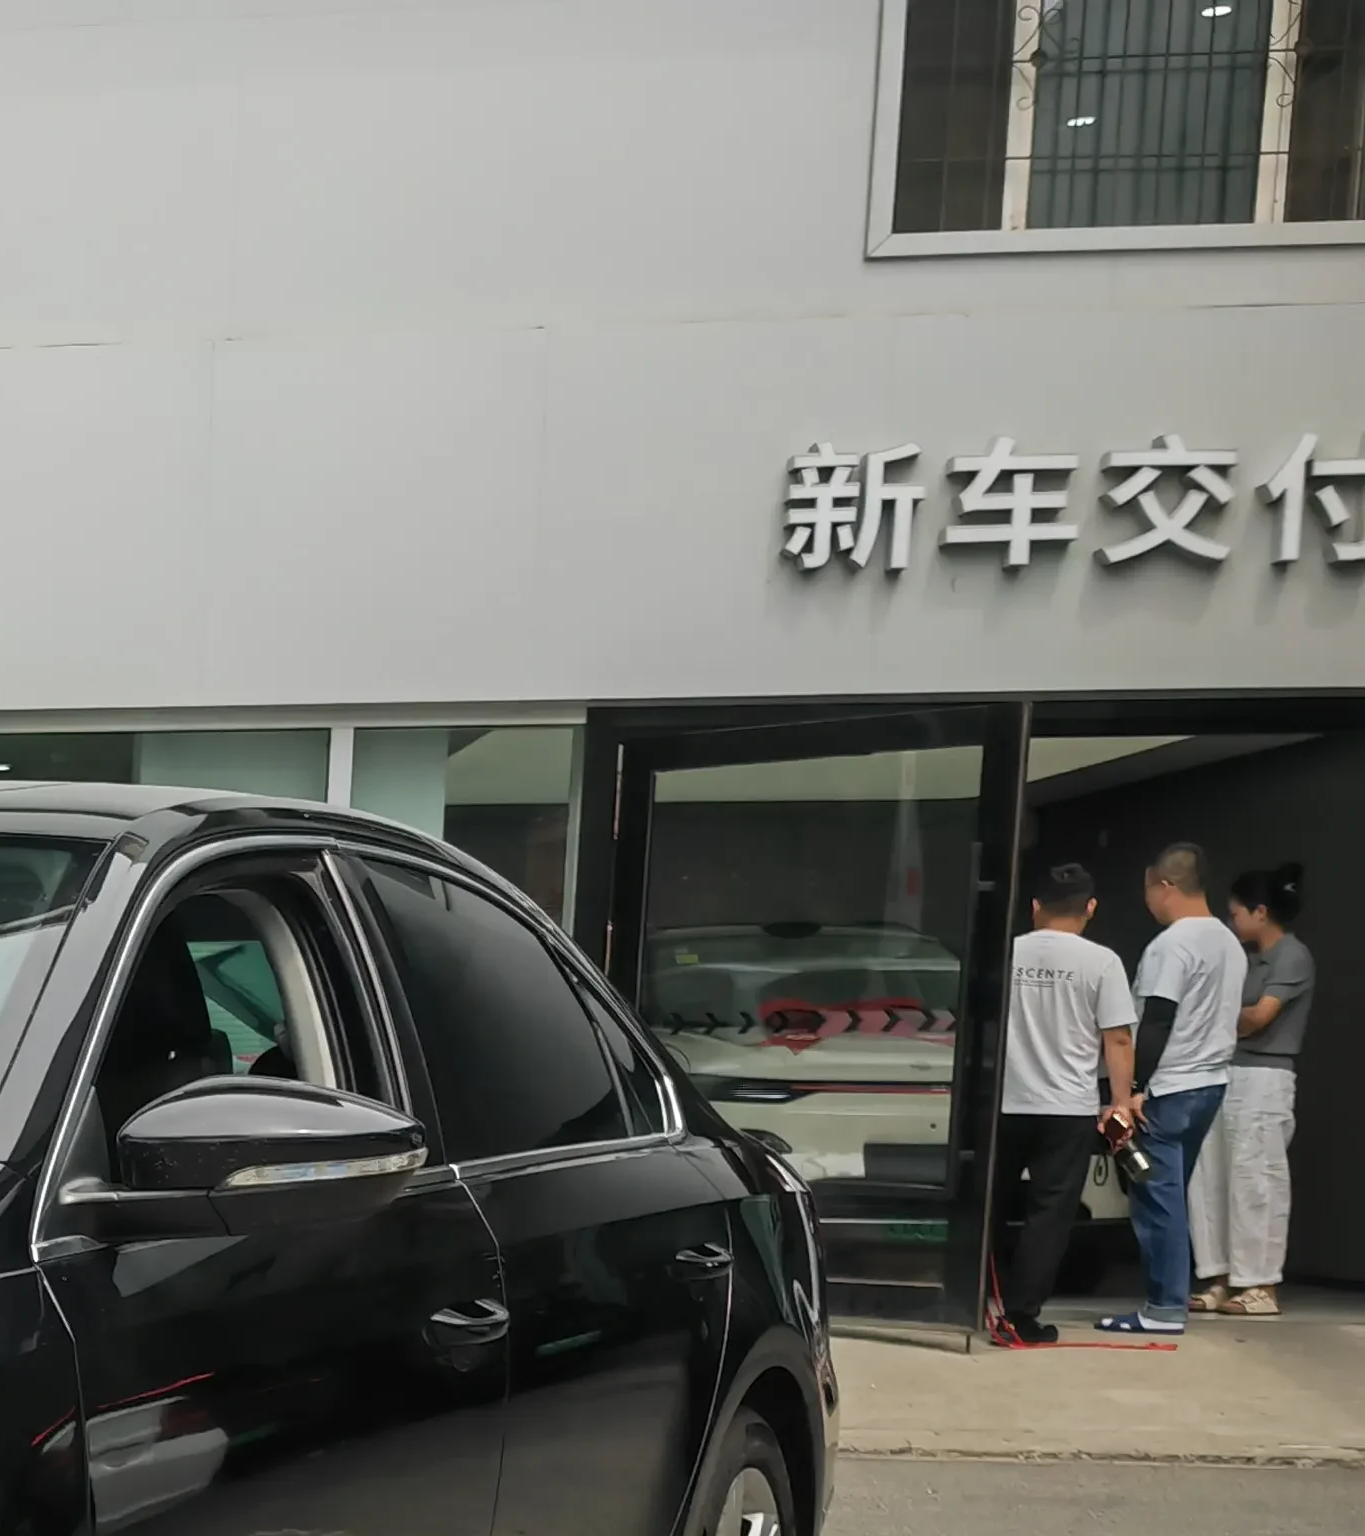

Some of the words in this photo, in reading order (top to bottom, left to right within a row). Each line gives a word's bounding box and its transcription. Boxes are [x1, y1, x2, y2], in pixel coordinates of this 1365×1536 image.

[781, 434, 1365, 571] 新车交付
[1012, 966, 1075, 982] SCENTE
